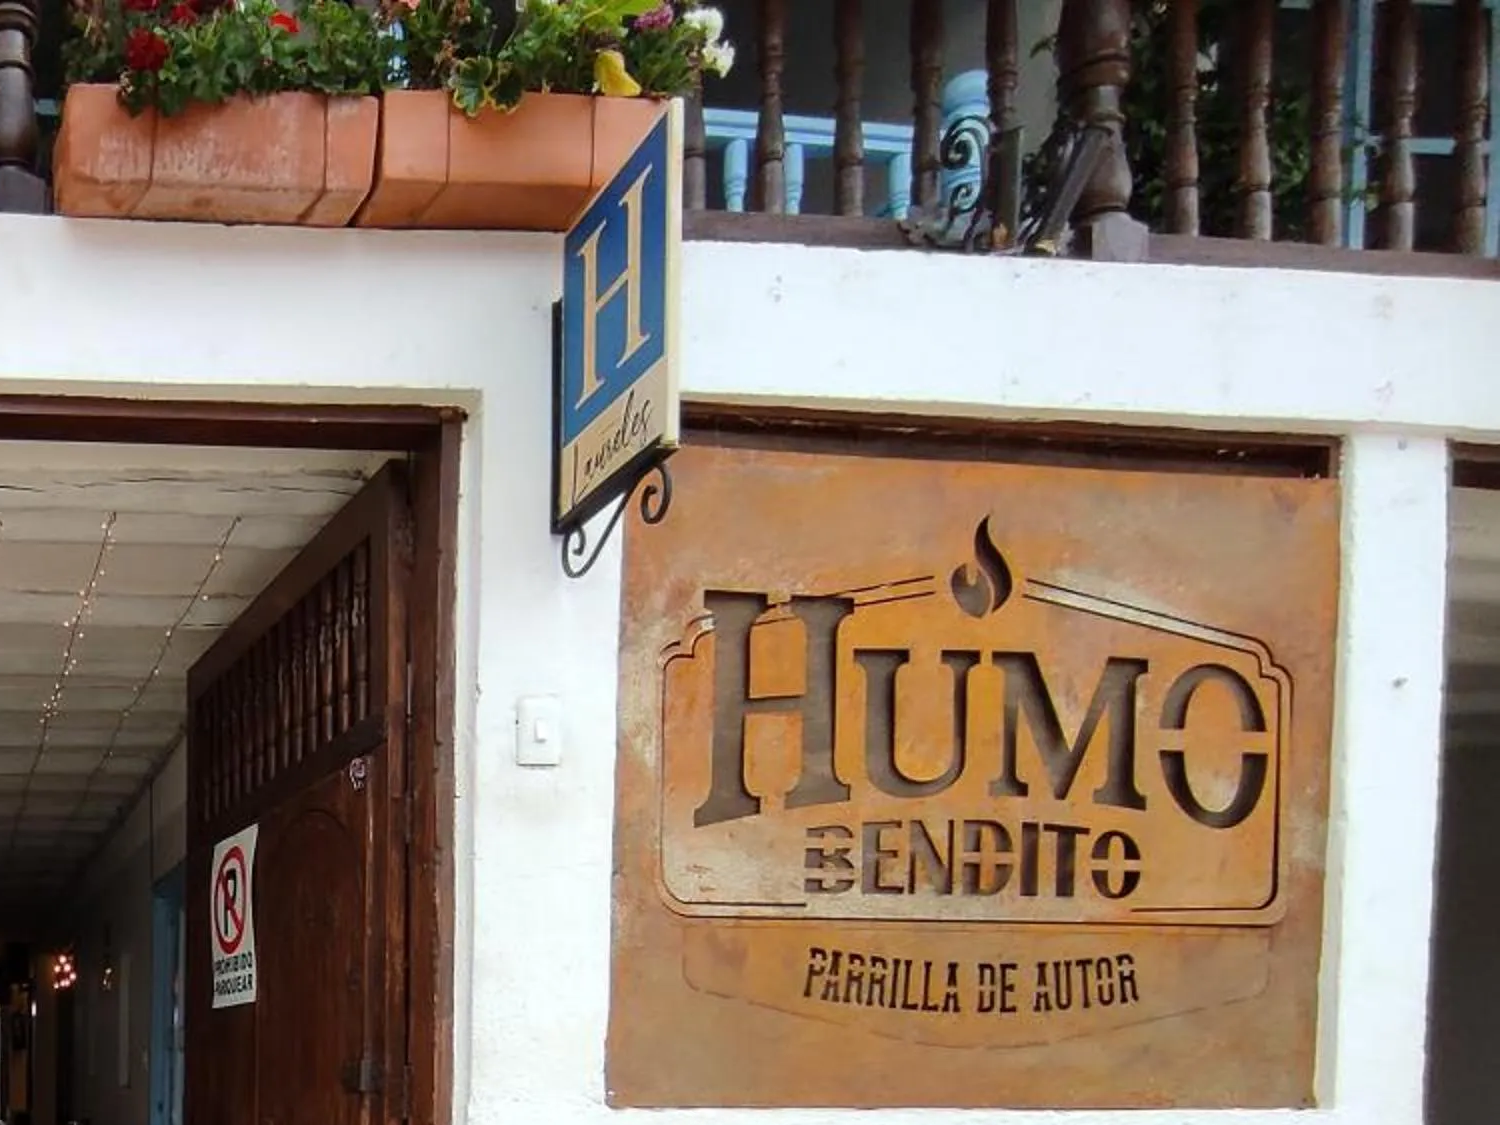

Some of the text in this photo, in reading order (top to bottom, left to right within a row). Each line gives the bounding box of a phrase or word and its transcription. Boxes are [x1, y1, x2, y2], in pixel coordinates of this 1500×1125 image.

[574, 162, 653, 412] H
[693, 588, 1269, 829] HUMO
[803, 819, 1141, 899] BENDITO
[803, 946, 1140, 1014] PARRILLA DE AUTOR
